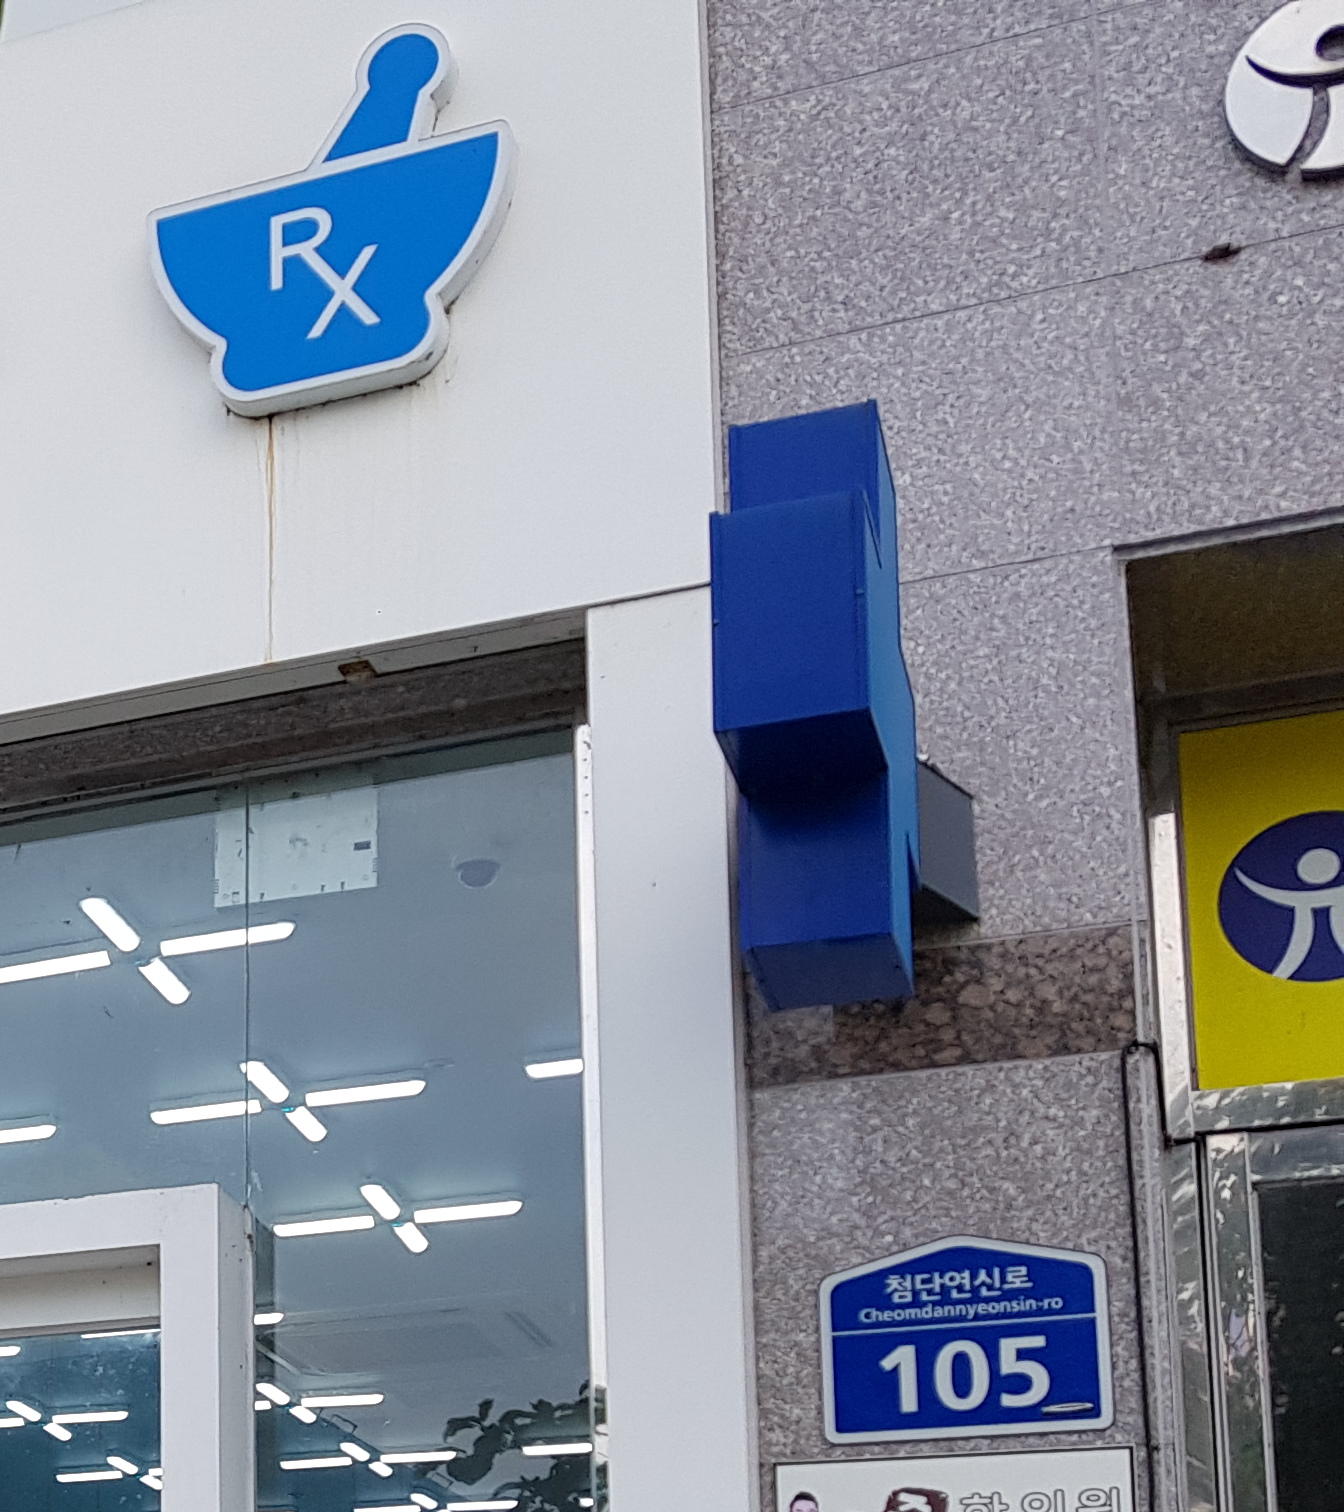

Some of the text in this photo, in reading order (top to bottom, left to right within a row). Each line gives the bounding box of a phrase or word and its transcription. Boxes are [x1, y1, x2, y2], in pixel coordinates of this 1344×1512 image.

[884, 1265, 1033, 1303] 첨단연신로
[859, 1294, 1064, 1326] Cheomdannyeonsin-ro
[879, 1335, 1052, 1415] 105
